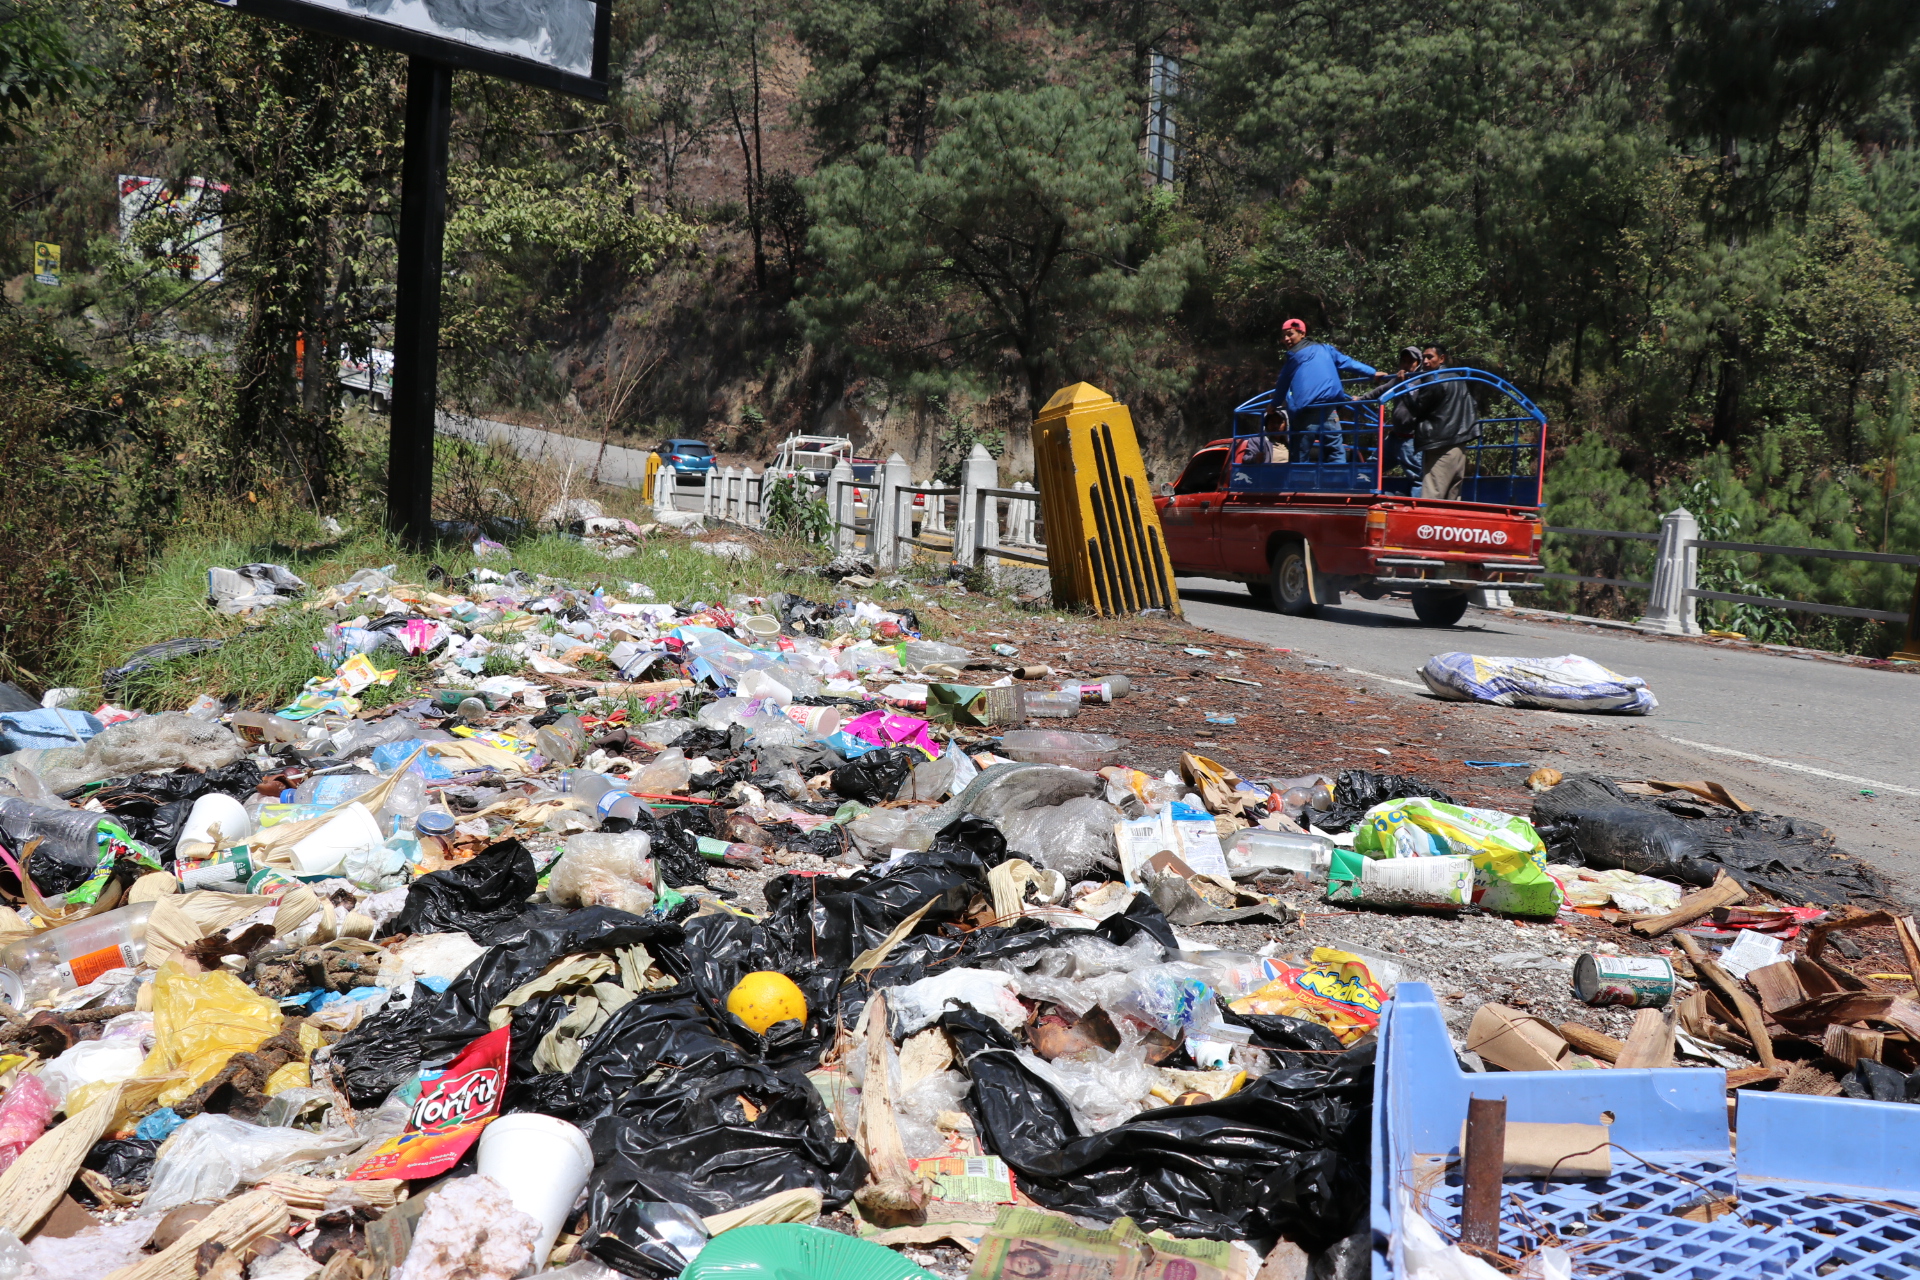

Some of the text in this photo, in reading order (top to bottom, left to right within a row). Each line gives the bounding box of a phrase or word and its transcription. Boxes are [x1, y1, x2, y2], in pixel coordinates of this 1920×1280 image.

[1433, 525, 1492, 544] TOYOTA
[1297, 969, 1382, 1015] Nachos
[388, 1218, 404, 1255] PARED
